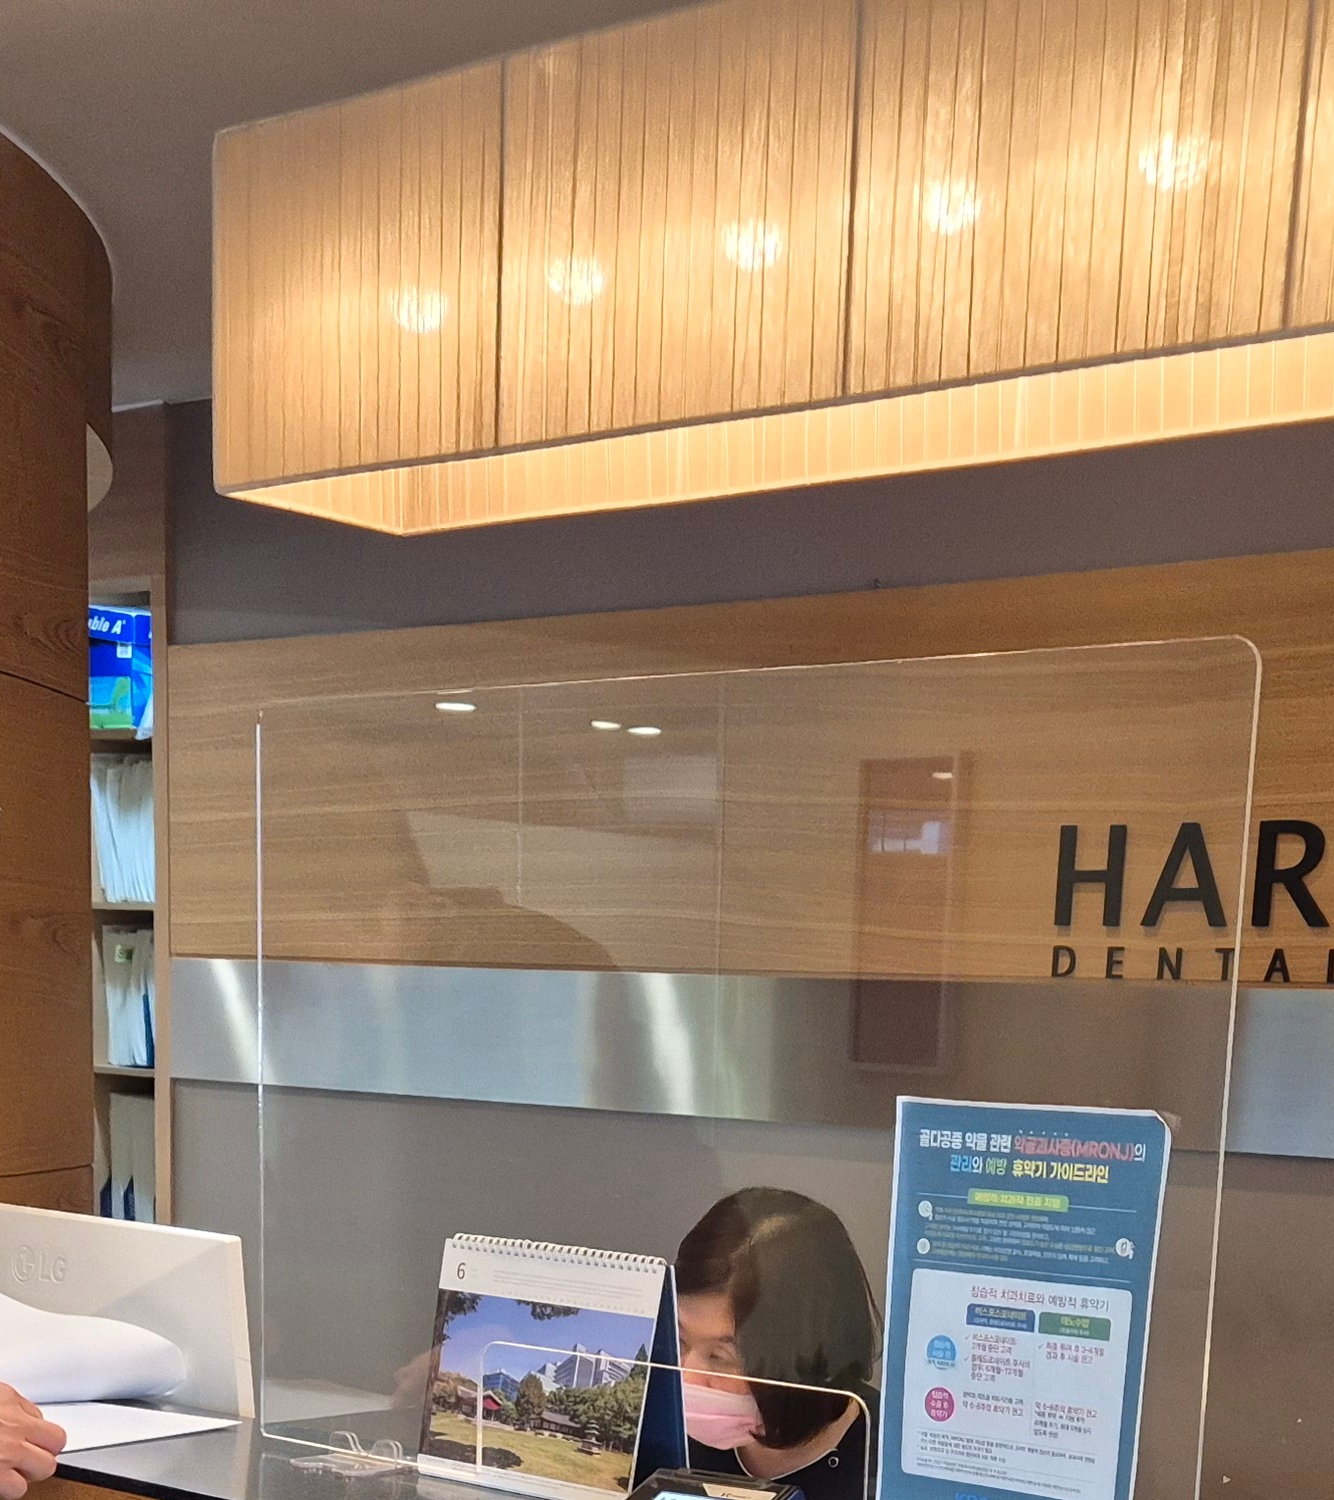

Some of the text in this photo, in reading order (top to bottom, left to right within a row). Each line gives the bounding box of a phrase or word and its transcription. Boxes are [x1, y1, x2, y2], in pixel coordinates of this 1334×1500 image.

[111, 619, 122, 635] A
[919, 1129, 962, 1150] 골다공증
[965, 1132, 988, 1152] 약물
[989, 1133, 1012, 1153] 관련
[950, 1154, 1109, 1184] 관리와 예방 휴약기 가이드라인
[37, 1252, 67, 1284] LG
[456, 1262, 466, 1280] 6
[1048, 1293, 1077, 1309] 예방적
[1079, 1297, 1110, 1312] 휴약기
